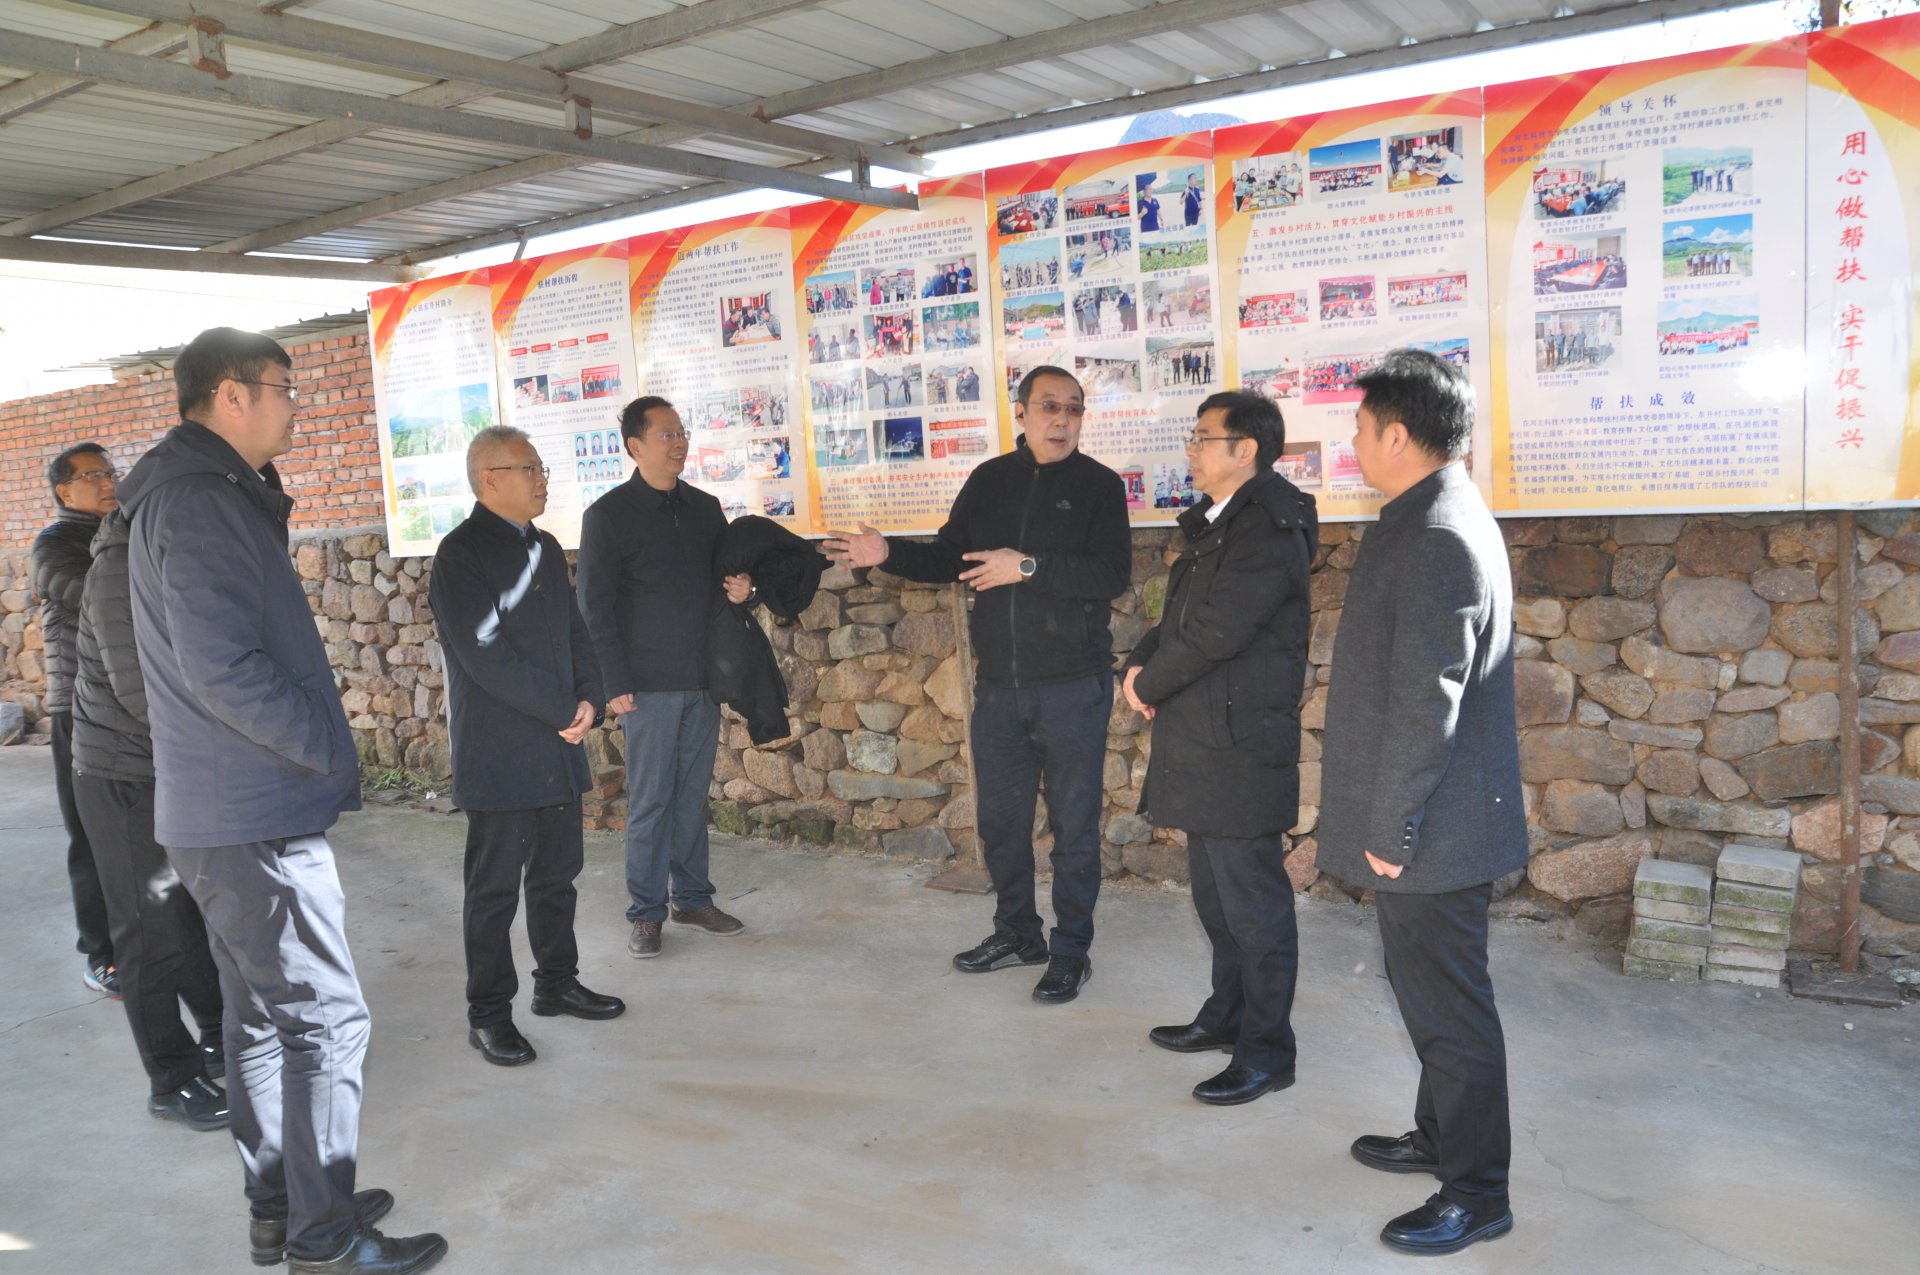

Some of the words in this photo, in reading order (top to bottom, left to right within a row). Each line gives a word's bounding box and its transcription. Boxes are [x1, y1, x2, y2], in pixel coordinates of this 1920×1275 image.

[1598, 93, 1678, 118] 领导关怀
[1835, 131, 1869, 285] 用心做帮扶
[678, 241, 739, 261] 近两年帮扶工作
[537, 273, 578, 289] 驻村帮扶历程
[1833, 303, 1868, 450] 实干促振兴
[1589, 390, 1697, 411] 帮扶成效
